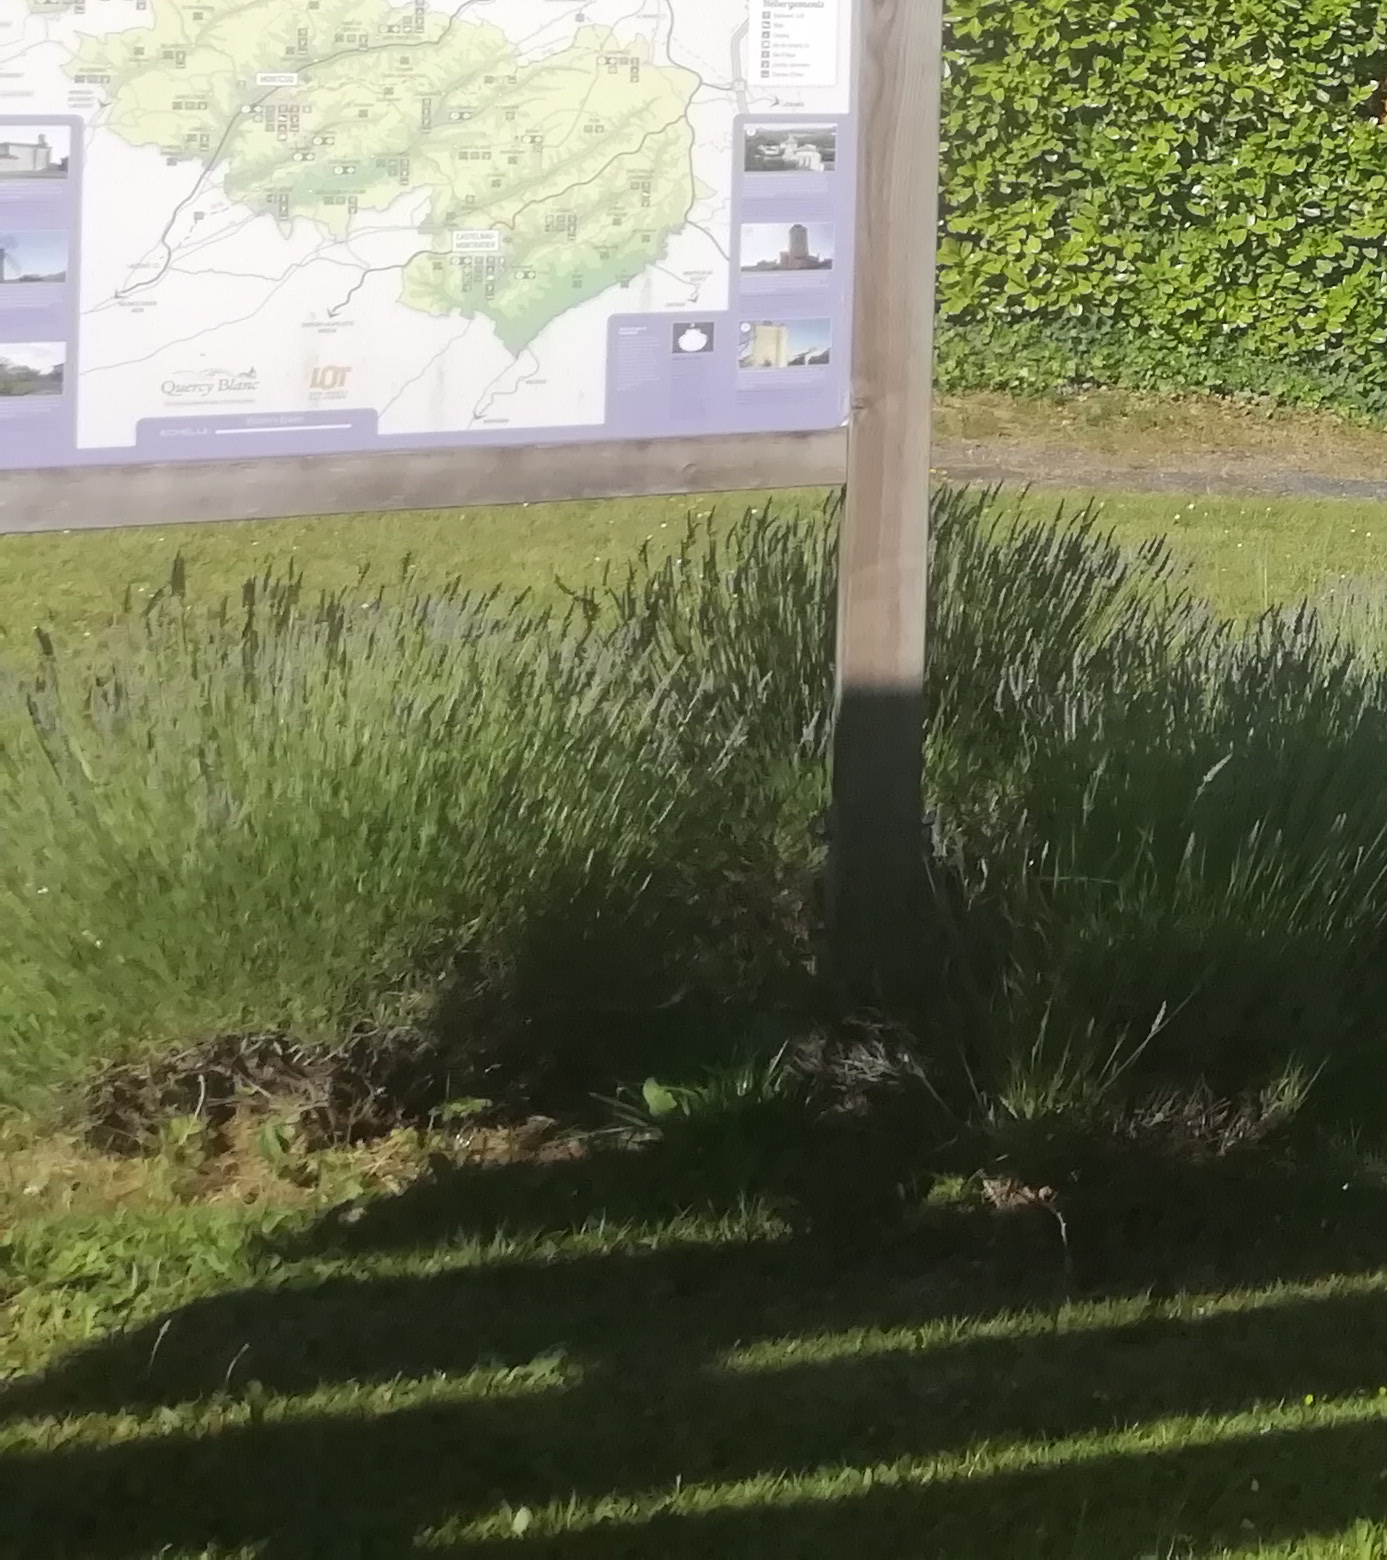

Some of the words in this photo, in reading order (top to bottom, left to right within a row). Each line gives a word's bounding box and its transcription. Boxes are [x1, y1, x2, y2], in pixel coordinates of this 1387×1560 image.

[161, 380, 214, 396] Quercy
[218, 378, 260, 392] Blanc
[309, 365, 352, 390] LOT
